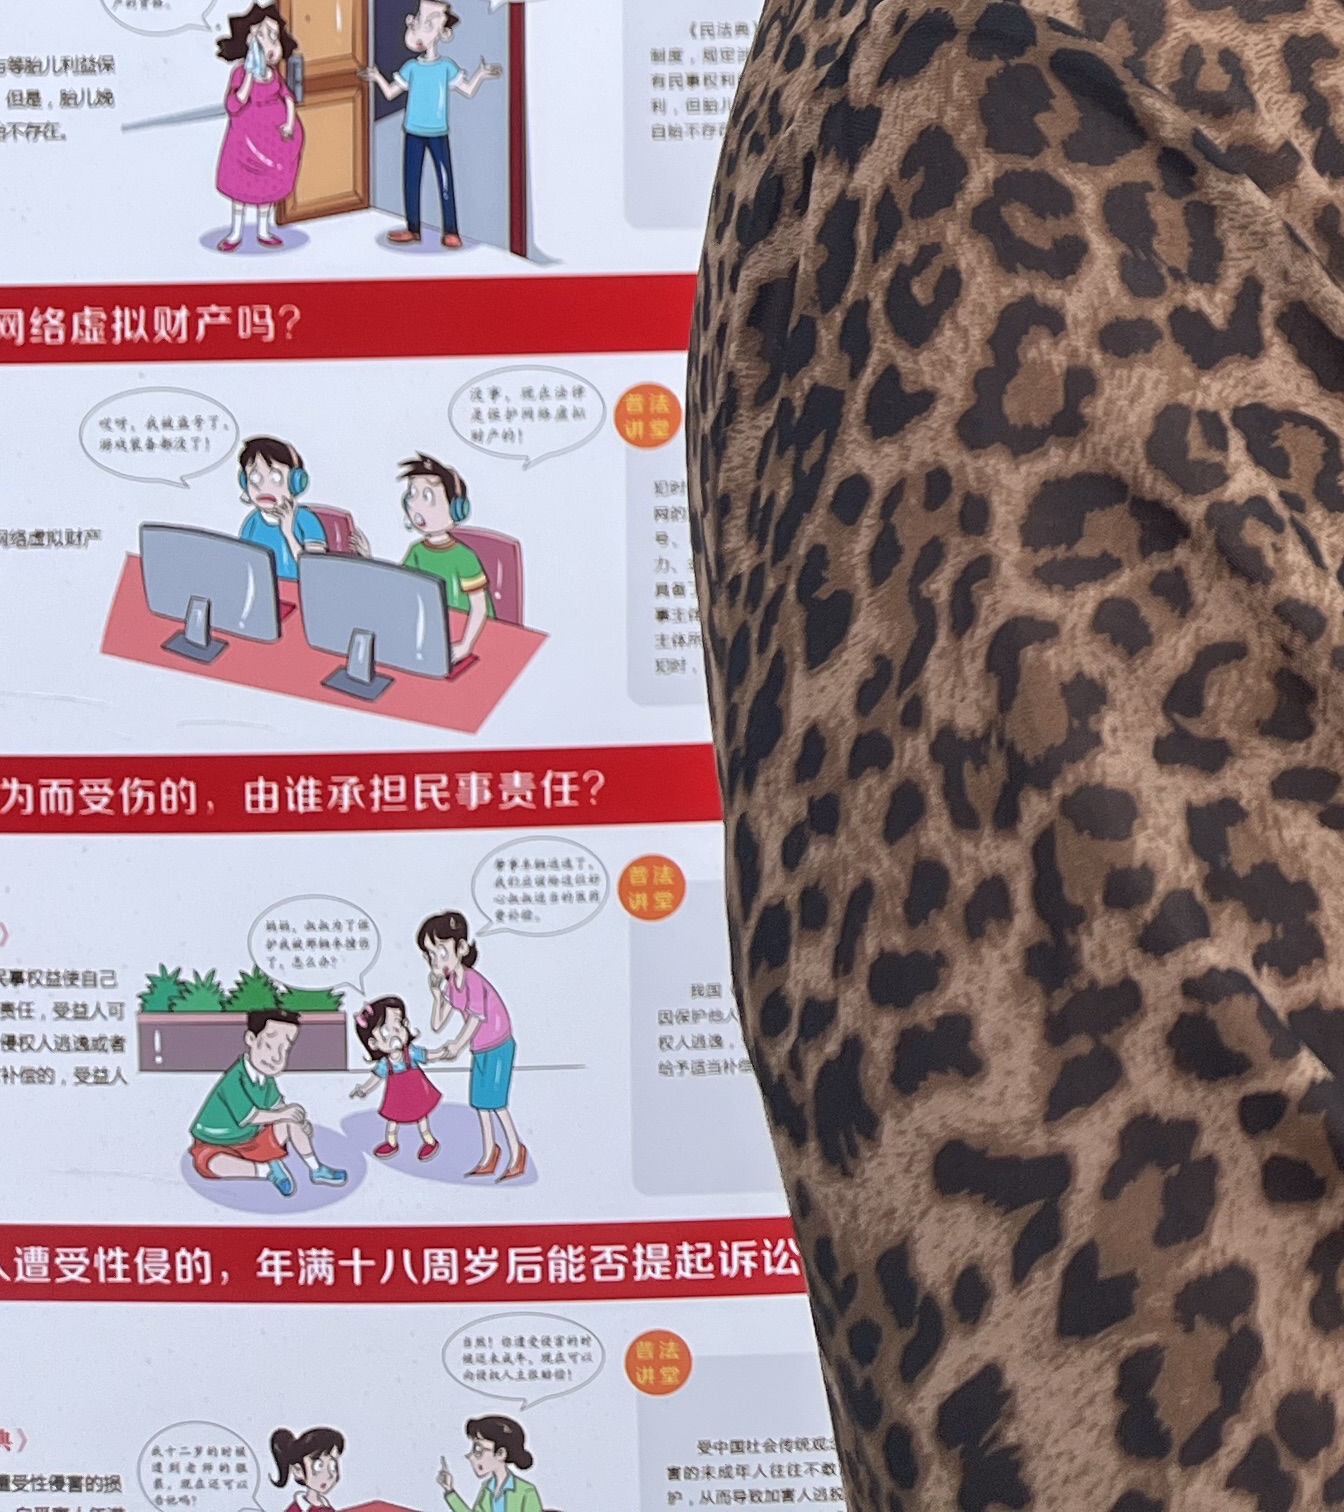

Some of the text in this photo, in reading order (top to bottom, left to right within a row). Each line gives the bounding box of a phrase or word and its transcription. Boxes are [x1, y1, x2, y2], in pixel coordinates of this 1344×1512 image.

[625, 392, 670, 414] 普法
[624, 419, 670, 440] 讲堂
[629, 864, 675, 887] 普法
[628, 890, 675, 912] 讲堂
[635, 1338, 680, 1361] 普法
[635, 1364, 681, 1386] 讲堂
